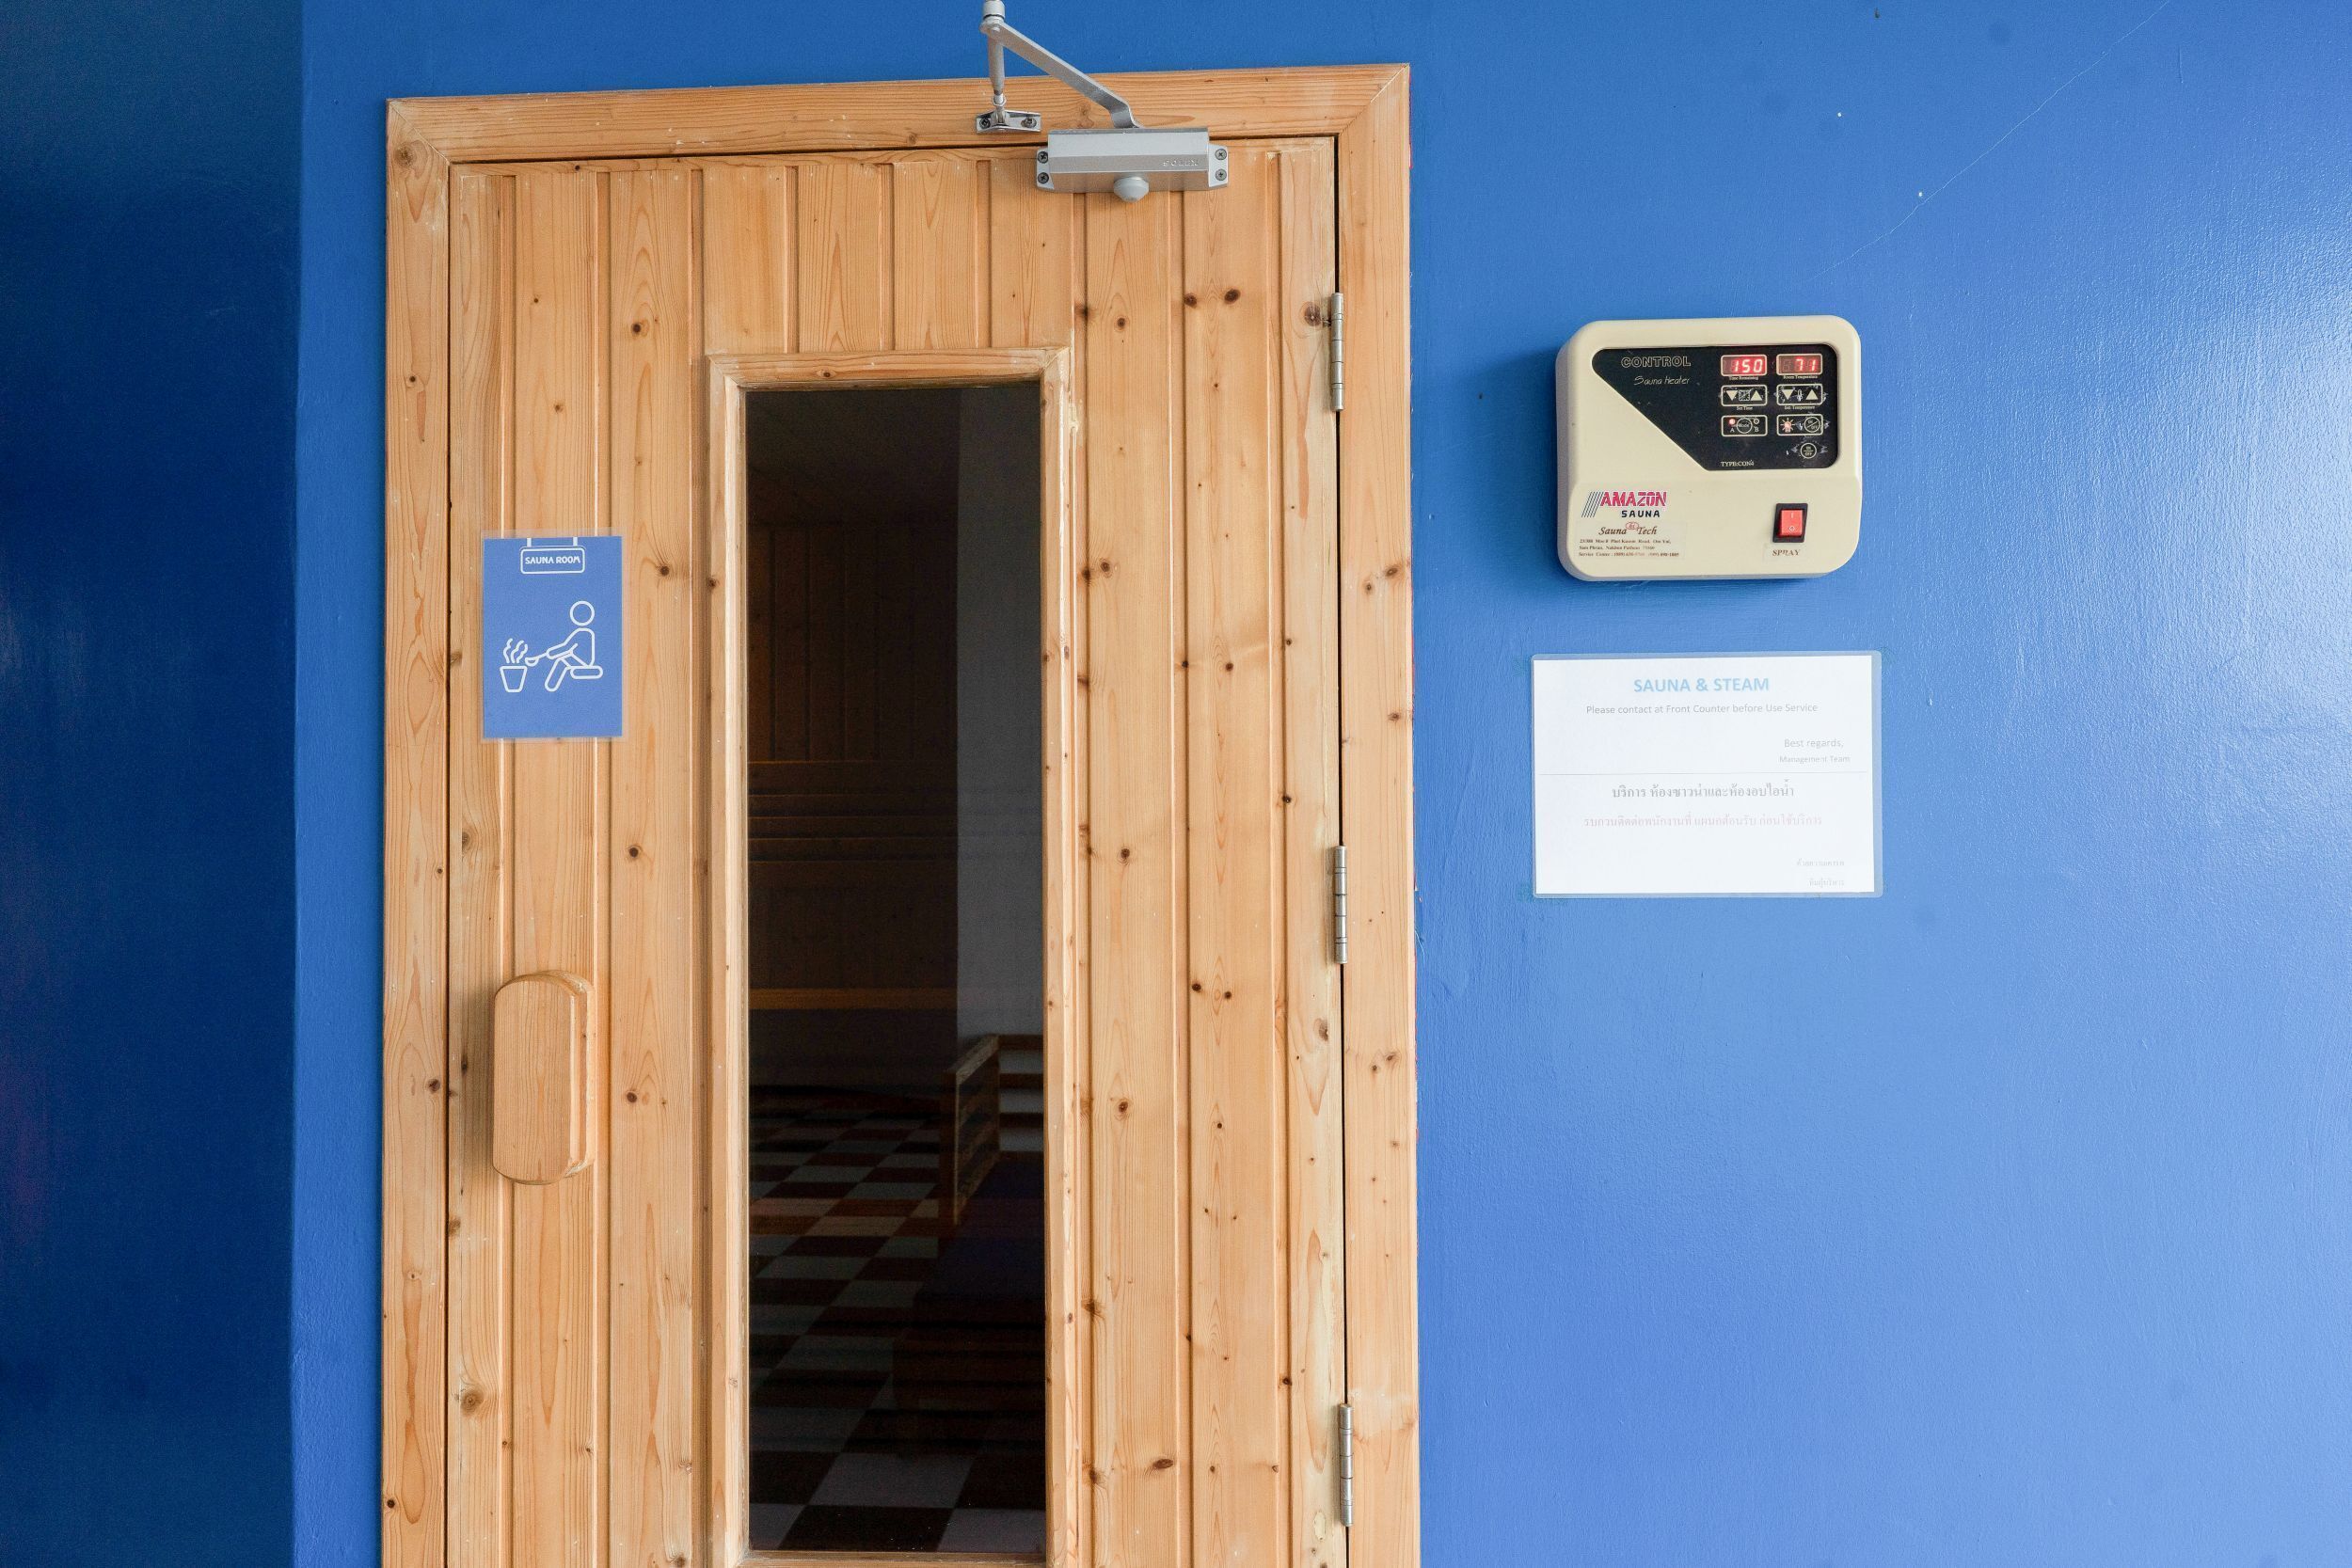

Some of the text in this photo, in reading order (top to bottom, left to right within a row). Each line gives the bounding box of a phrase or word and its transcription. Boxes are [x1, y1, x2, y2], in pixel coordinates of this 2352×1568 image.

[1621, 356, 1692, 368] CONTROL
[1733, 358, 1763, 372] 150
[1795, 358, 1817, 372] 71
[1634, 375, 1661, 386] Sauna
[1599, 491, 1667, 507] AMAZON
[1621, 510, 1661, 518] SAUNA
[1598, 526, 1627, 536] Sauna
[1636, 526, 1658, 535] Tech
[525, 555, 580, 564] SAUNA ROOM
[1634, 677, 1770, 692] SAUNA & STEAM
[1586, 703, 1818, 714] Please contact at Front Counter before Use Service
[1784, 738, 1844, 749] Best regards,
[1779, 755, 1827, 764] Management
[1612, 784, 1646, 798] บริการ
